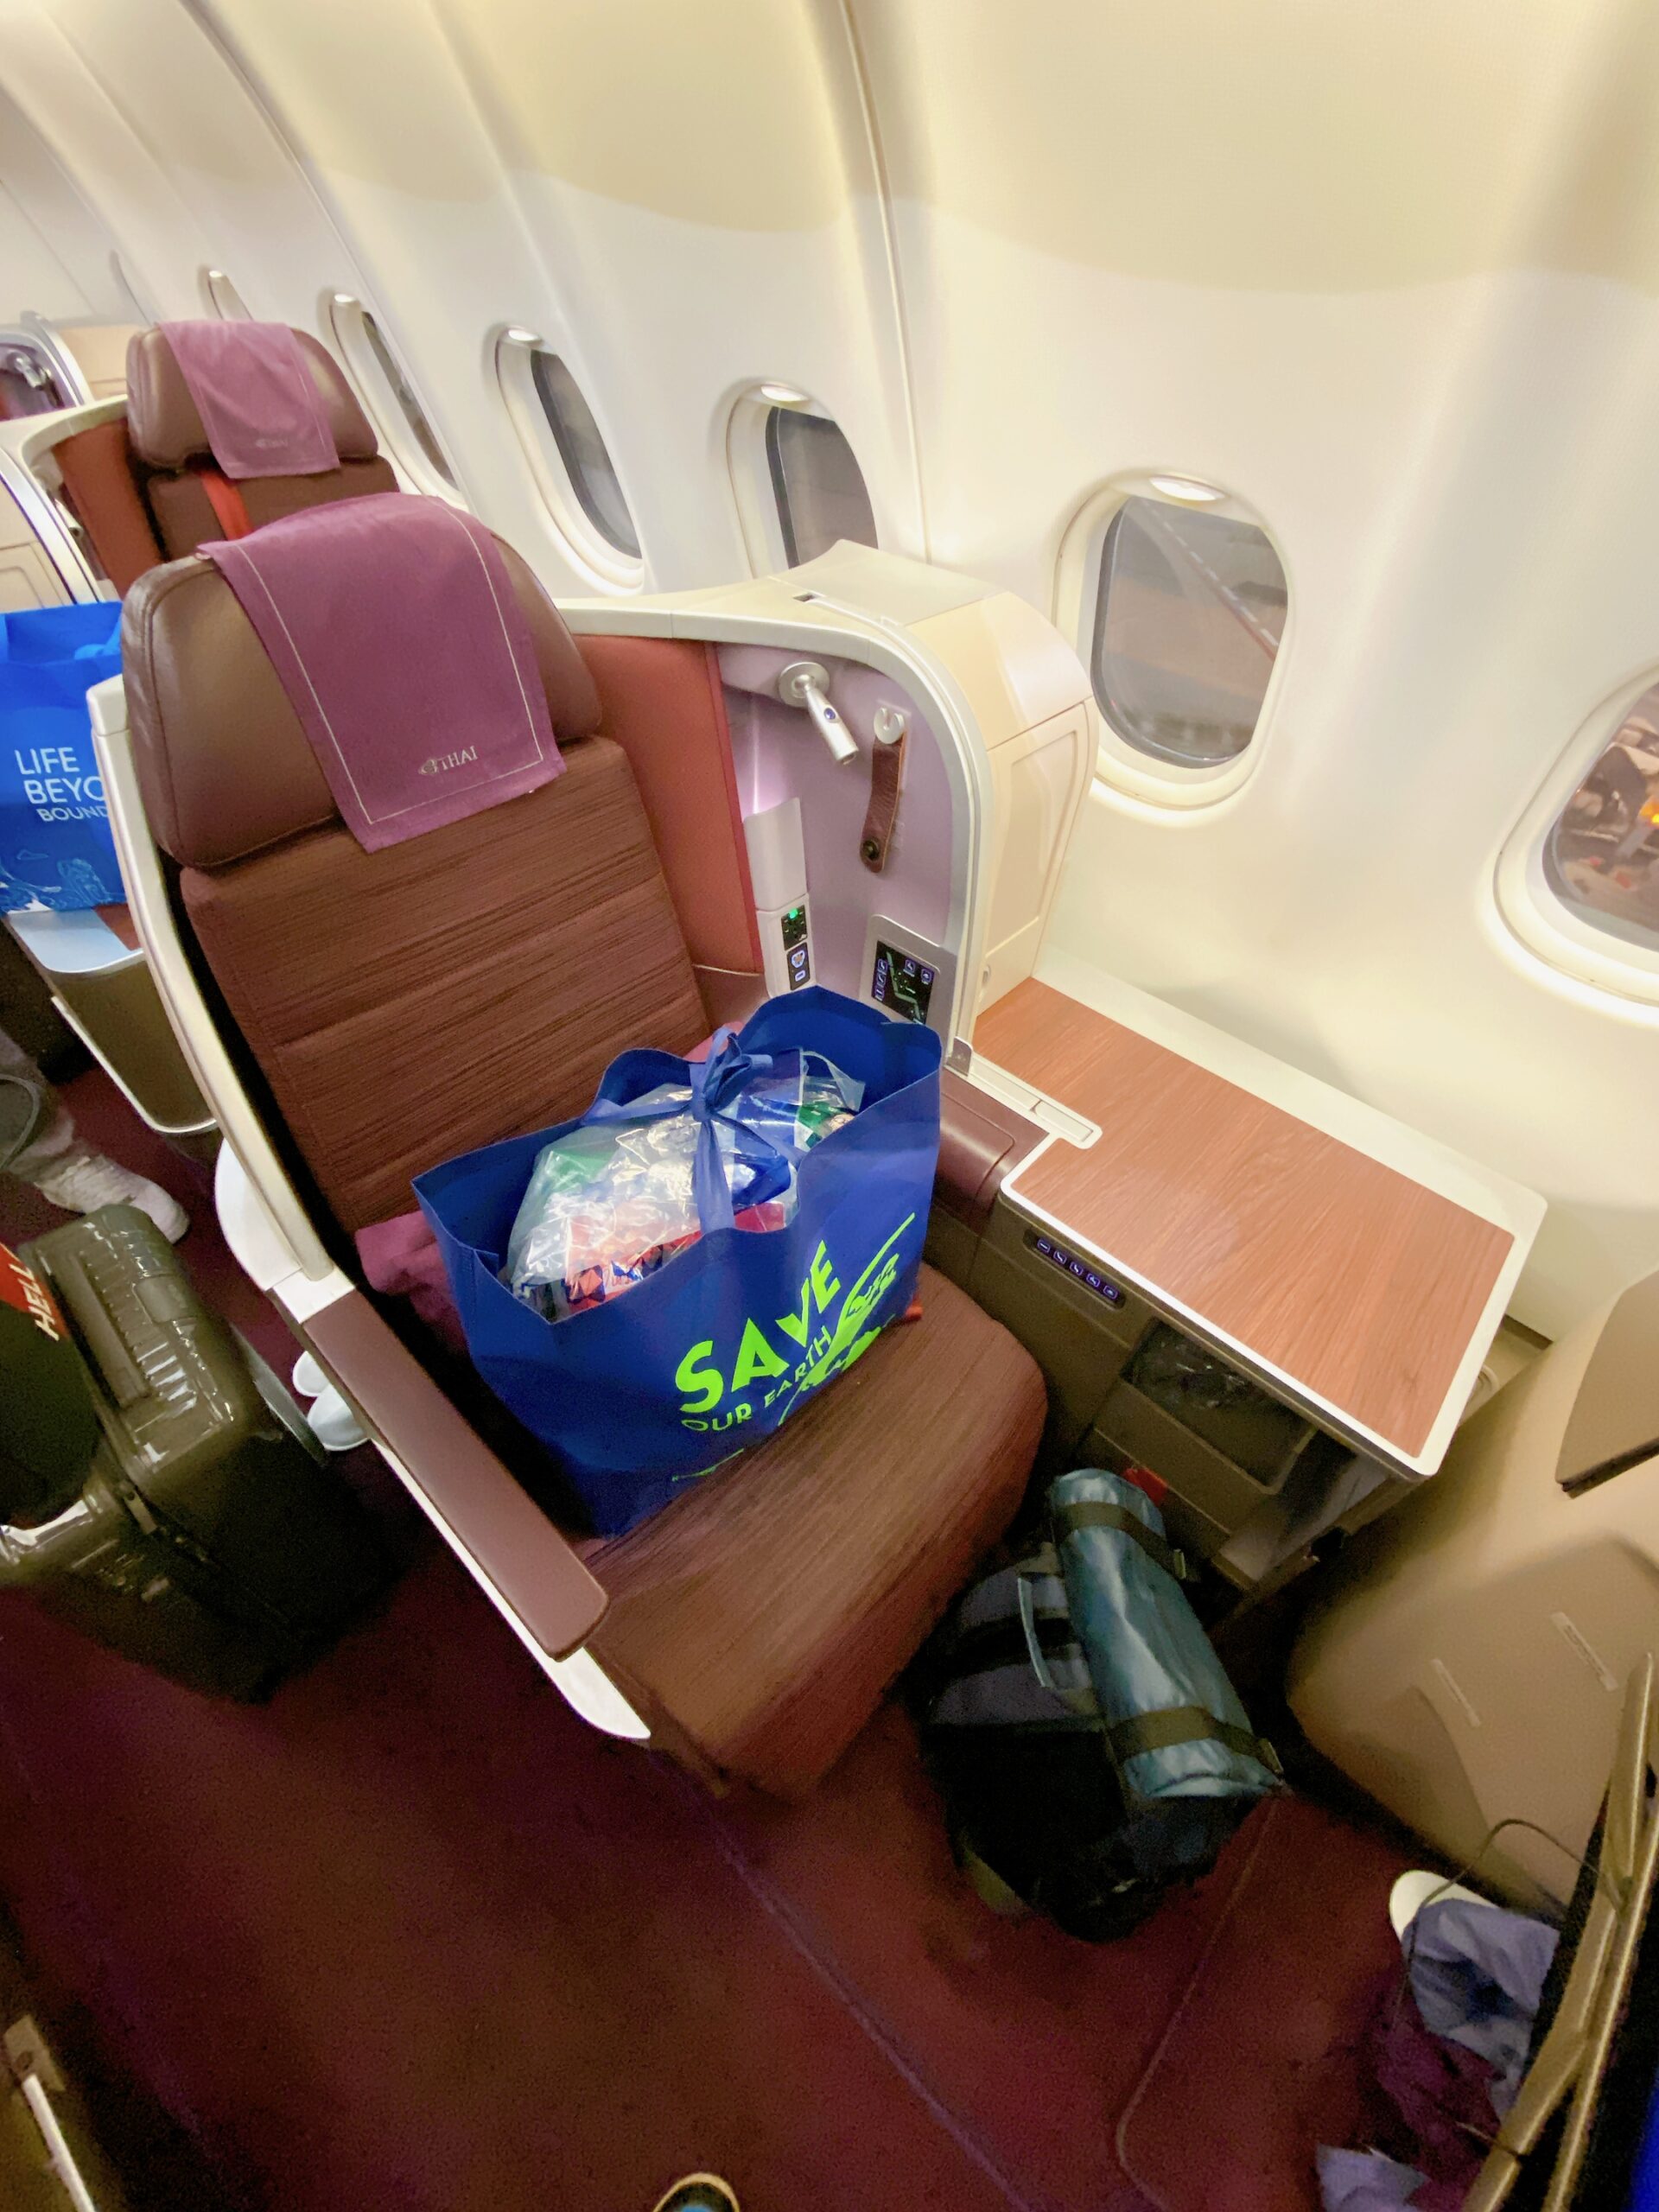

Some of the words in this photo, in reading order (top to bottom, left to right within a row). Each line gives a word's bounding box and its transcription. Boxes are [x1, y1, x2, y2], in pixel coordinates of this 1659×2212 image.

[15, 747, 80, 775] LIFE
[439, 745, 479, 771] THAI
[675, 1239, 842, 1414] SAVE
[681, 1402, 752, 1432] OUR
[764, 1325, 832, 1408] EARTH
